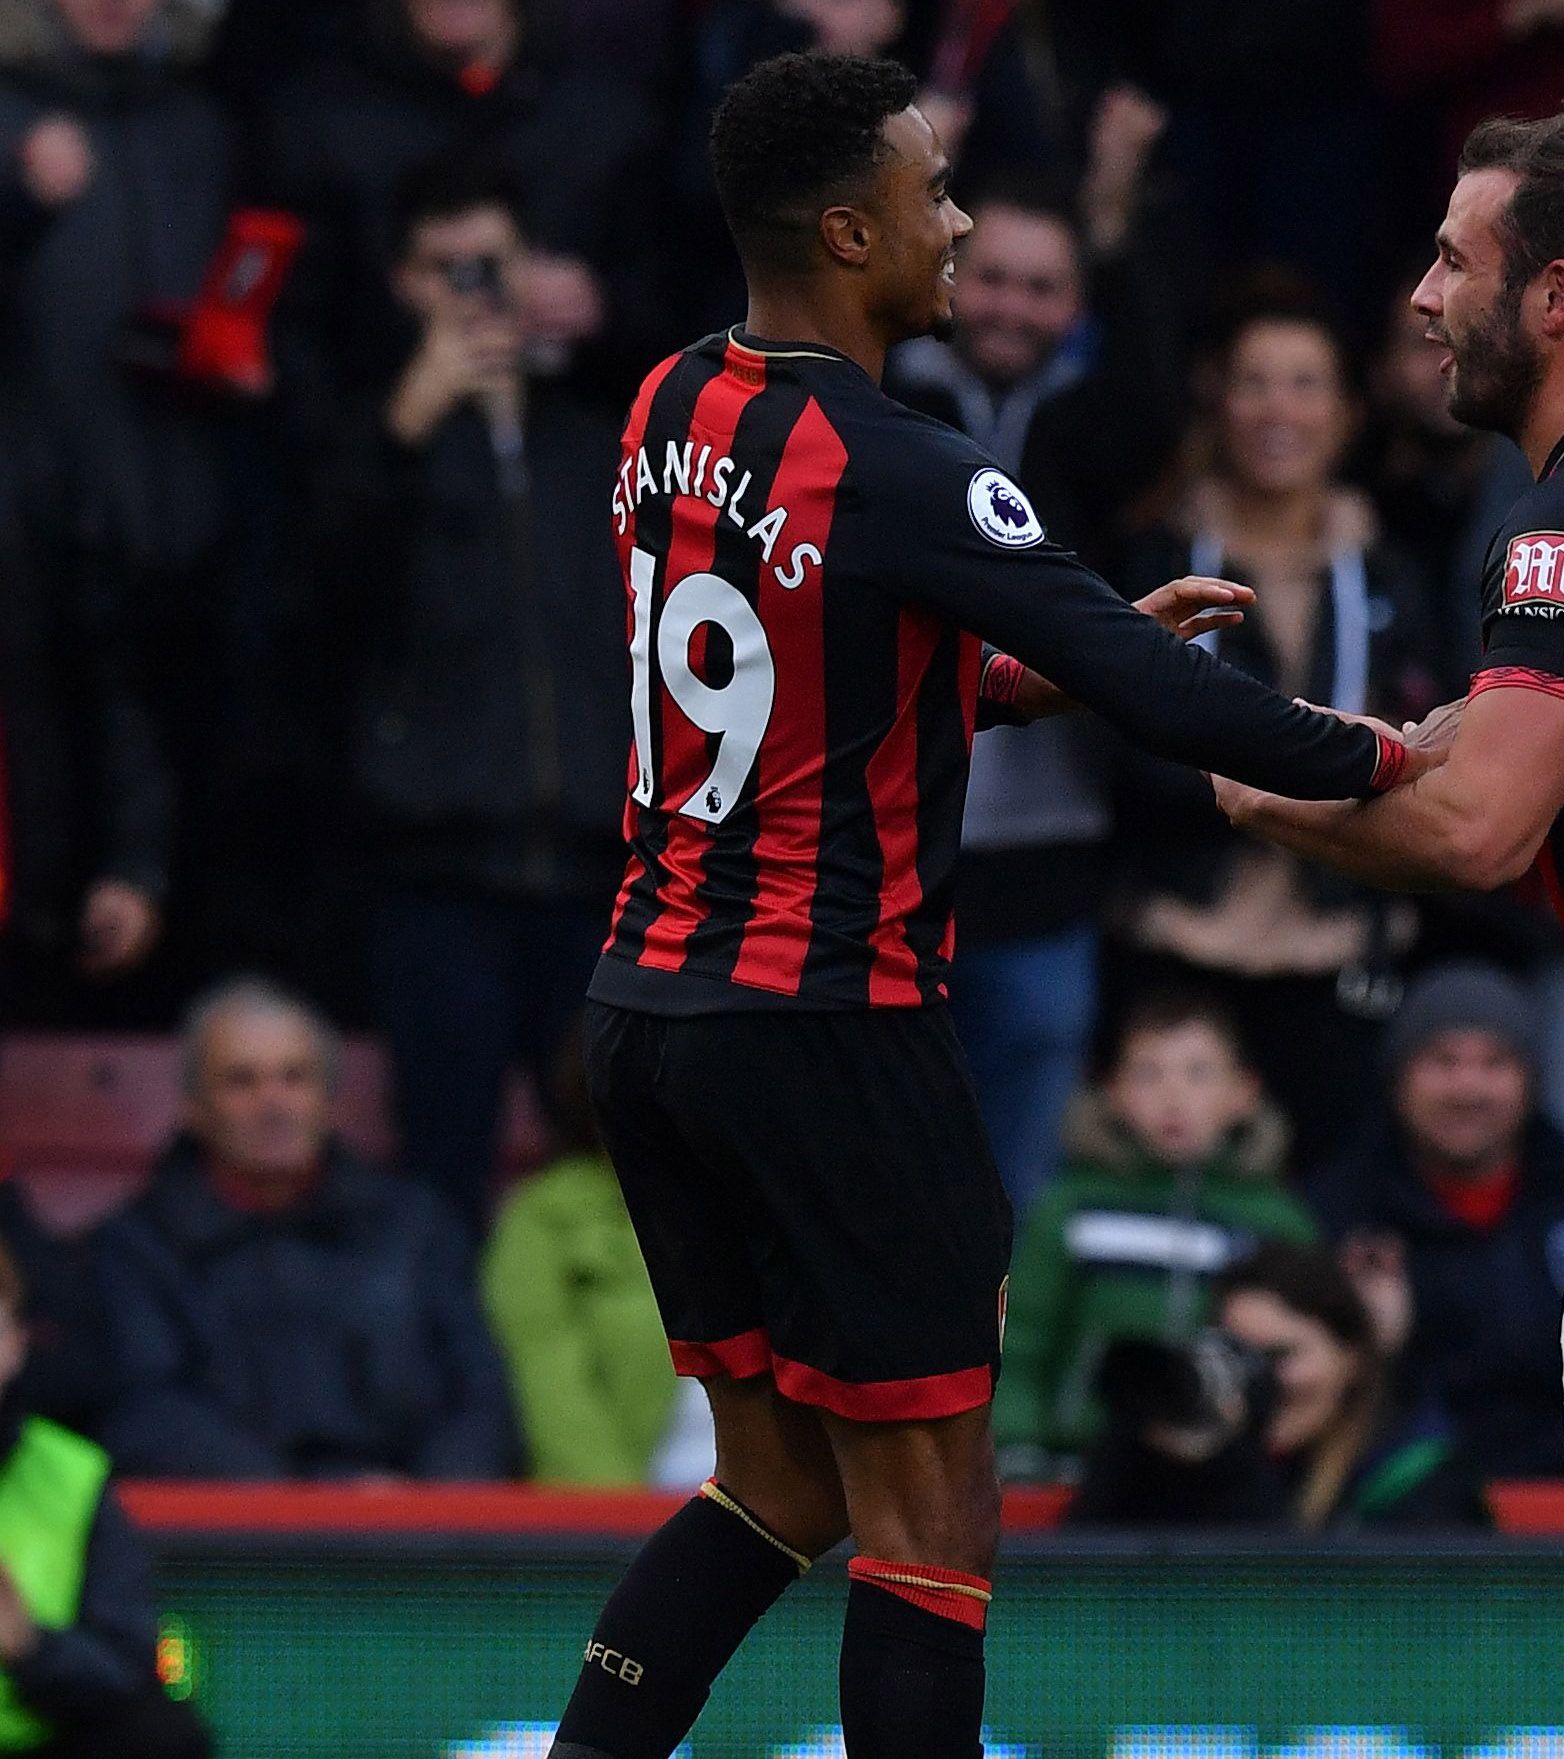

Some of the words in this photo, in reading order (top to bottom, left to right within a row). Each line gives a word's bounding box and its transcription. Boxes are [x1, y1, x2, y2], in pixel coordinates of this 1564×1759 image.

[612, 440, 822, 590] STANISLAS
[981, 516, 1006, 539] Premier
[1007, 532, 1034, 541] League
[629, 545, 777, 824] 19
